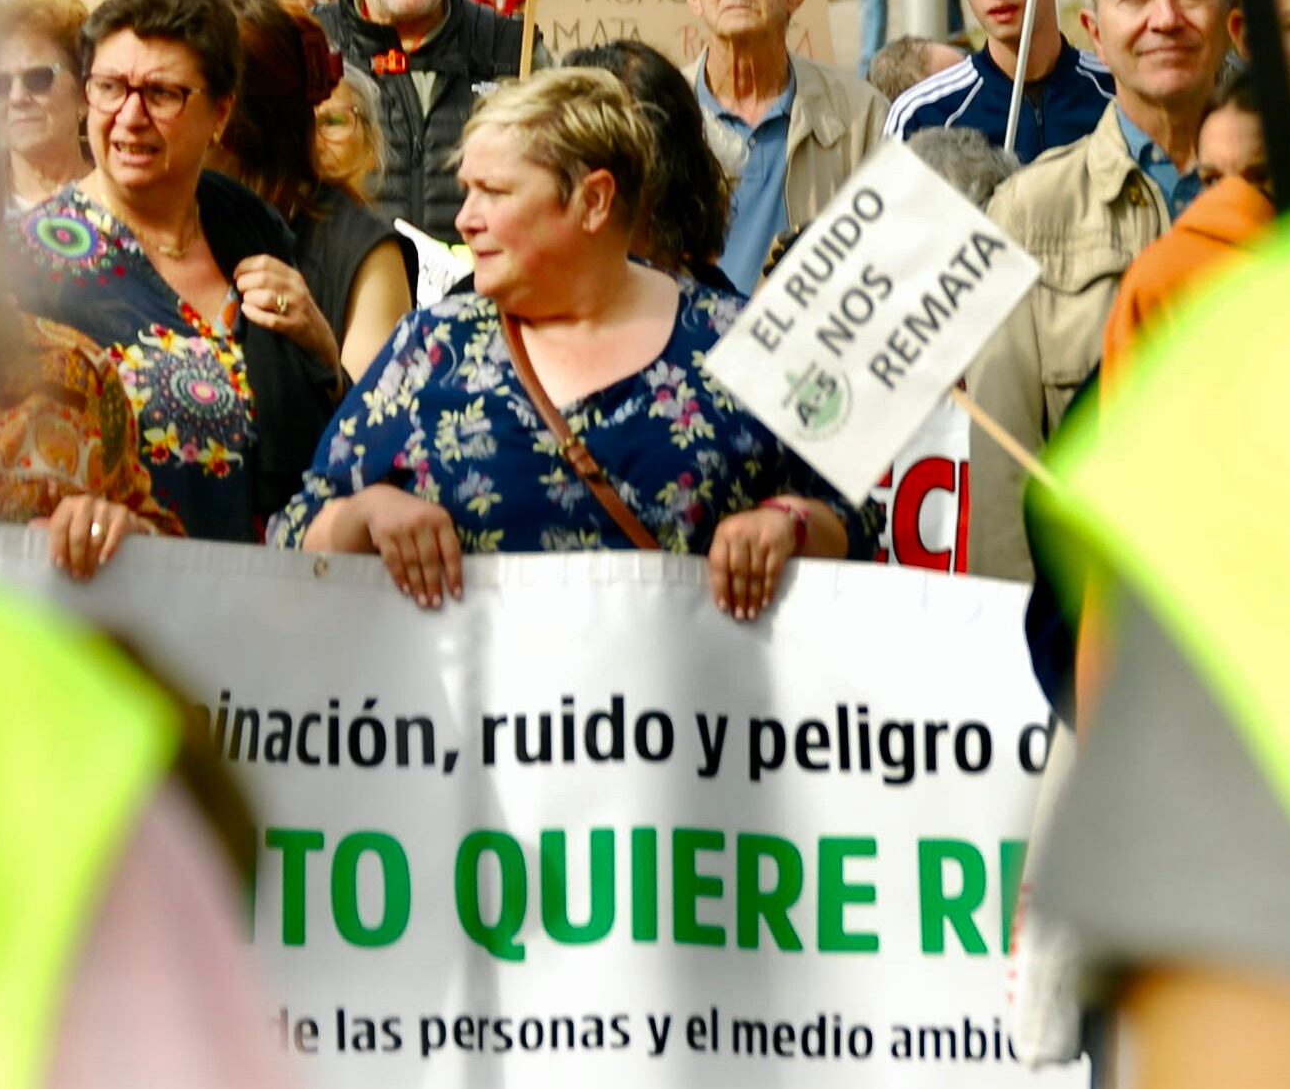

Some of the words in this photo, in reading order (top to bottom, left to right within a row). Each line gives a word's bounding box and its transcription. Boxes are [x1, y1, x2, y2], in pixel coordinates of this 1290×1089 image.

[750, 307, 795, 354] EL
[783, 187, 884, 309] RUIDO
[815, 264, 893, 358] NOS
[868, 228, 1007, 391] REMATA
[482, 694, 676, 768] ruido
[695, 712, 729, 779] y
[749, 704, 995, 786] peligro
[241, 827, 412, 949] TO
[455, 827, 879, 961] QUIERE
[336, 1005, 404, 1054] las
[419, 1012, 631, 1058] personas
[646, 1013, 672, 1058] y
[686, 1005, 719, 1053] el
[732, 1012, 874, 1059] medio
